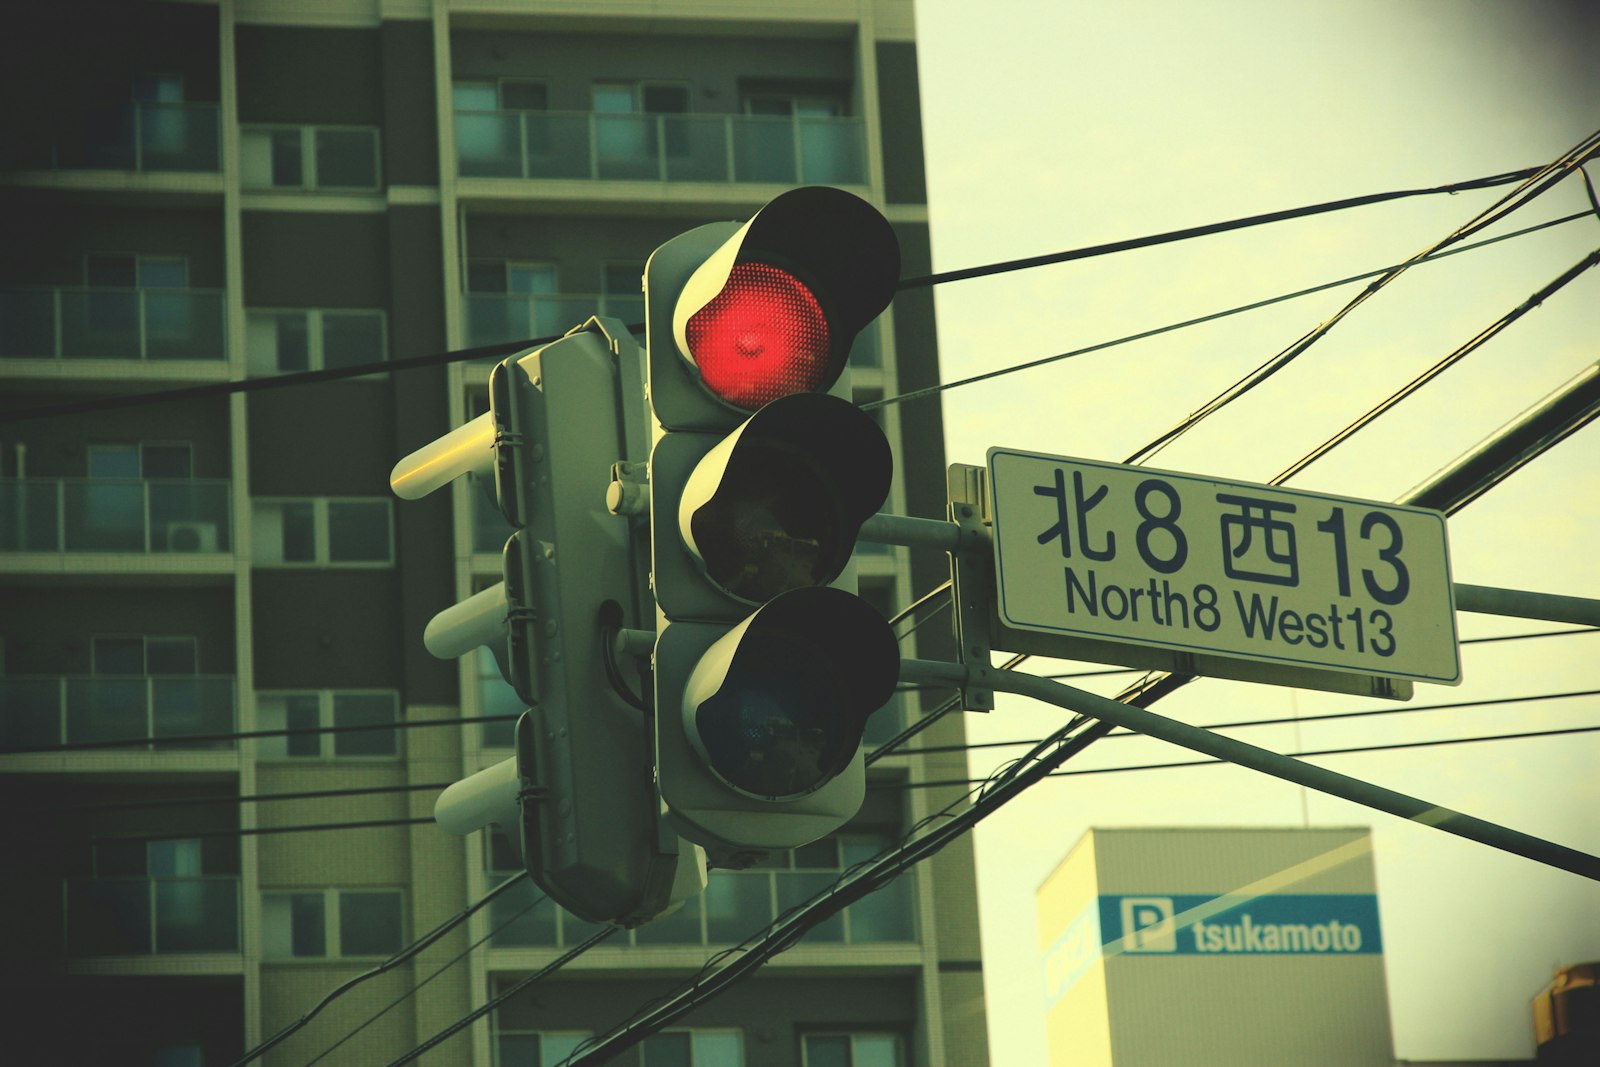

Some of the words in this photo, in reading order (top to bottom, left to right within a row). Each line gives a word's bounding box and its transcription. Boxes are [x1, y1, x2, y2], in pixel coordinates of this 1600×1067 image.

[1063, 566, 1222, 633] North8
[1232, 589, 1397, 658] West13
[1192, 913, 1363, 952] tsukamoto
